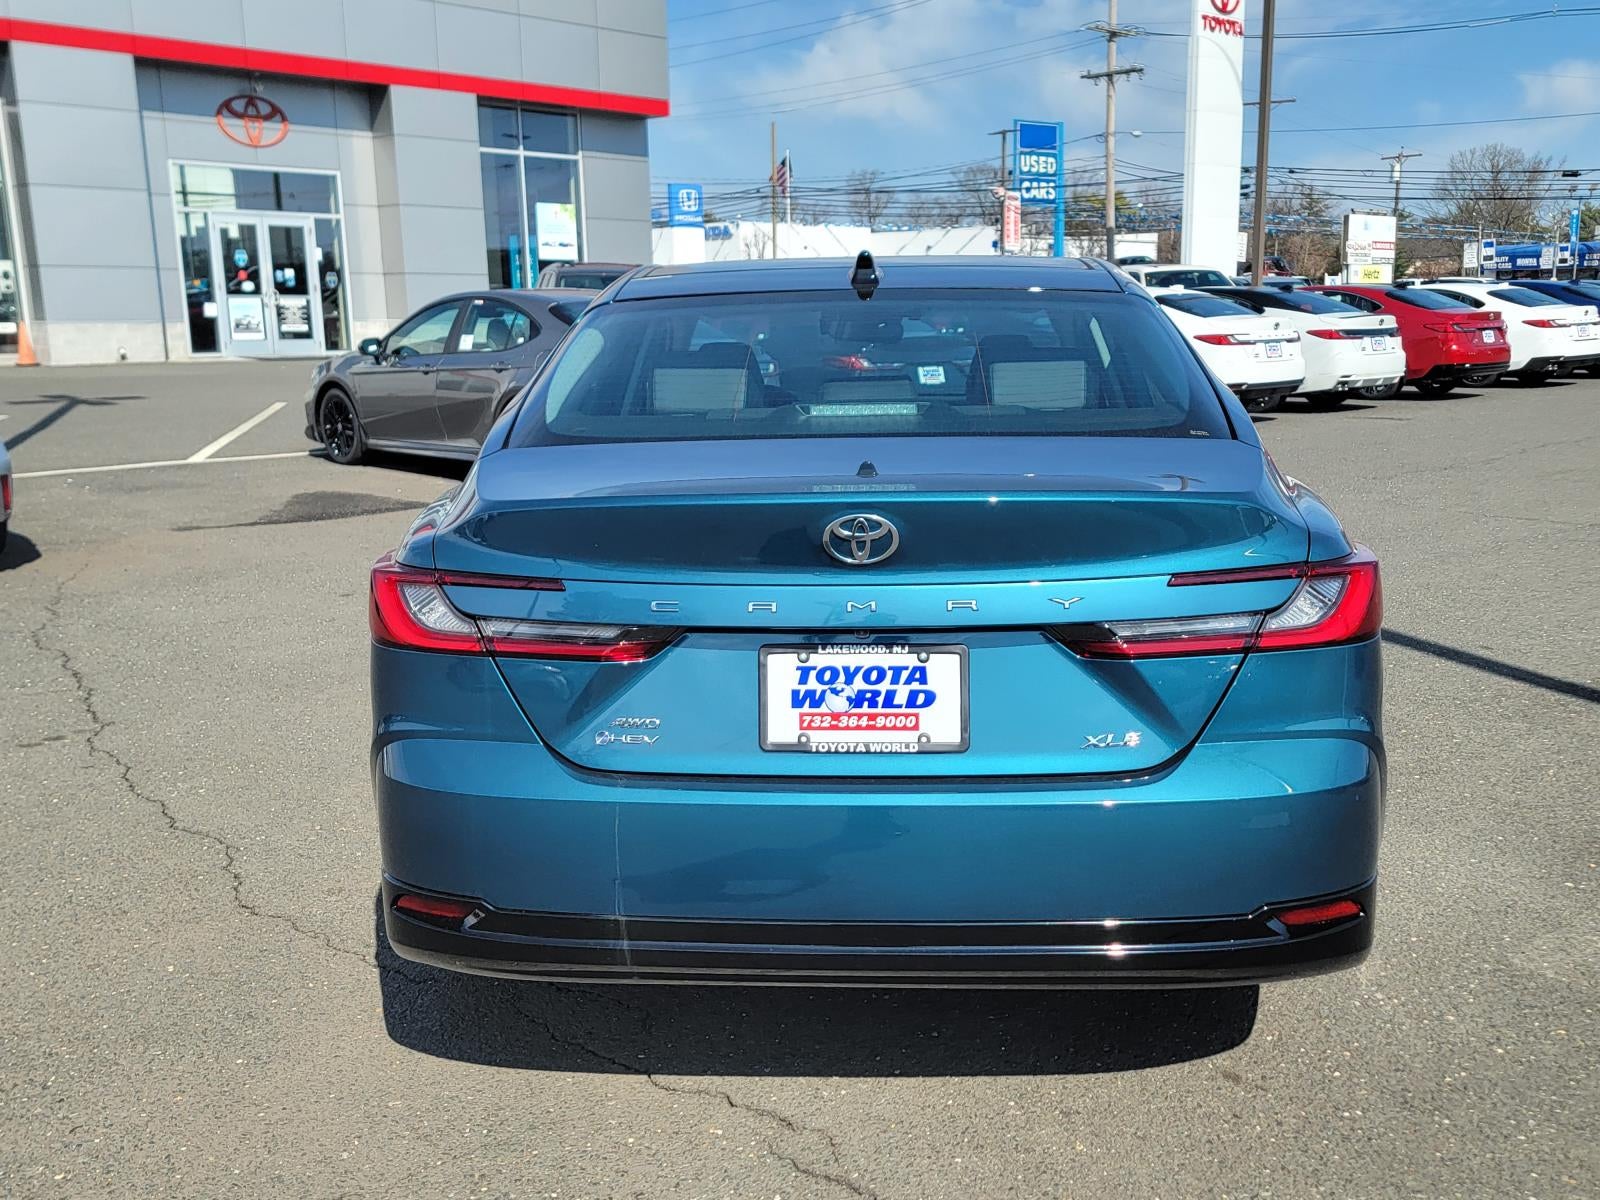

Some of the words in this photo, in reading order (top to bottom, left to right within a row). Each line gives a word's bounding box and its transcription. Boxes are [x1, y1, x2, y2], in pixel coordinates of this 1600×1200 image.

[1202, 14, 1244, 36] TOYOTA
[1020, 154, 1056, 174] USED
[1021, 181, 1056, 199] CARS
[650, 597, 1084, 613] CAMRY
[892, 645, 909, 654] NJ
[796, 666, 928, 685] TOYOTA
[791, 686, 937, 711] WORLD
[608, 717, 660, 728] AWD
[801, 715, 917, 728] 732-364-9000
[609, 733, 660, 744] HEV
[1080, 731, 1142, 749] XLE
[810, 742, 867, 753] TOYOTA
[869, 742, 919, 753] WORLD
